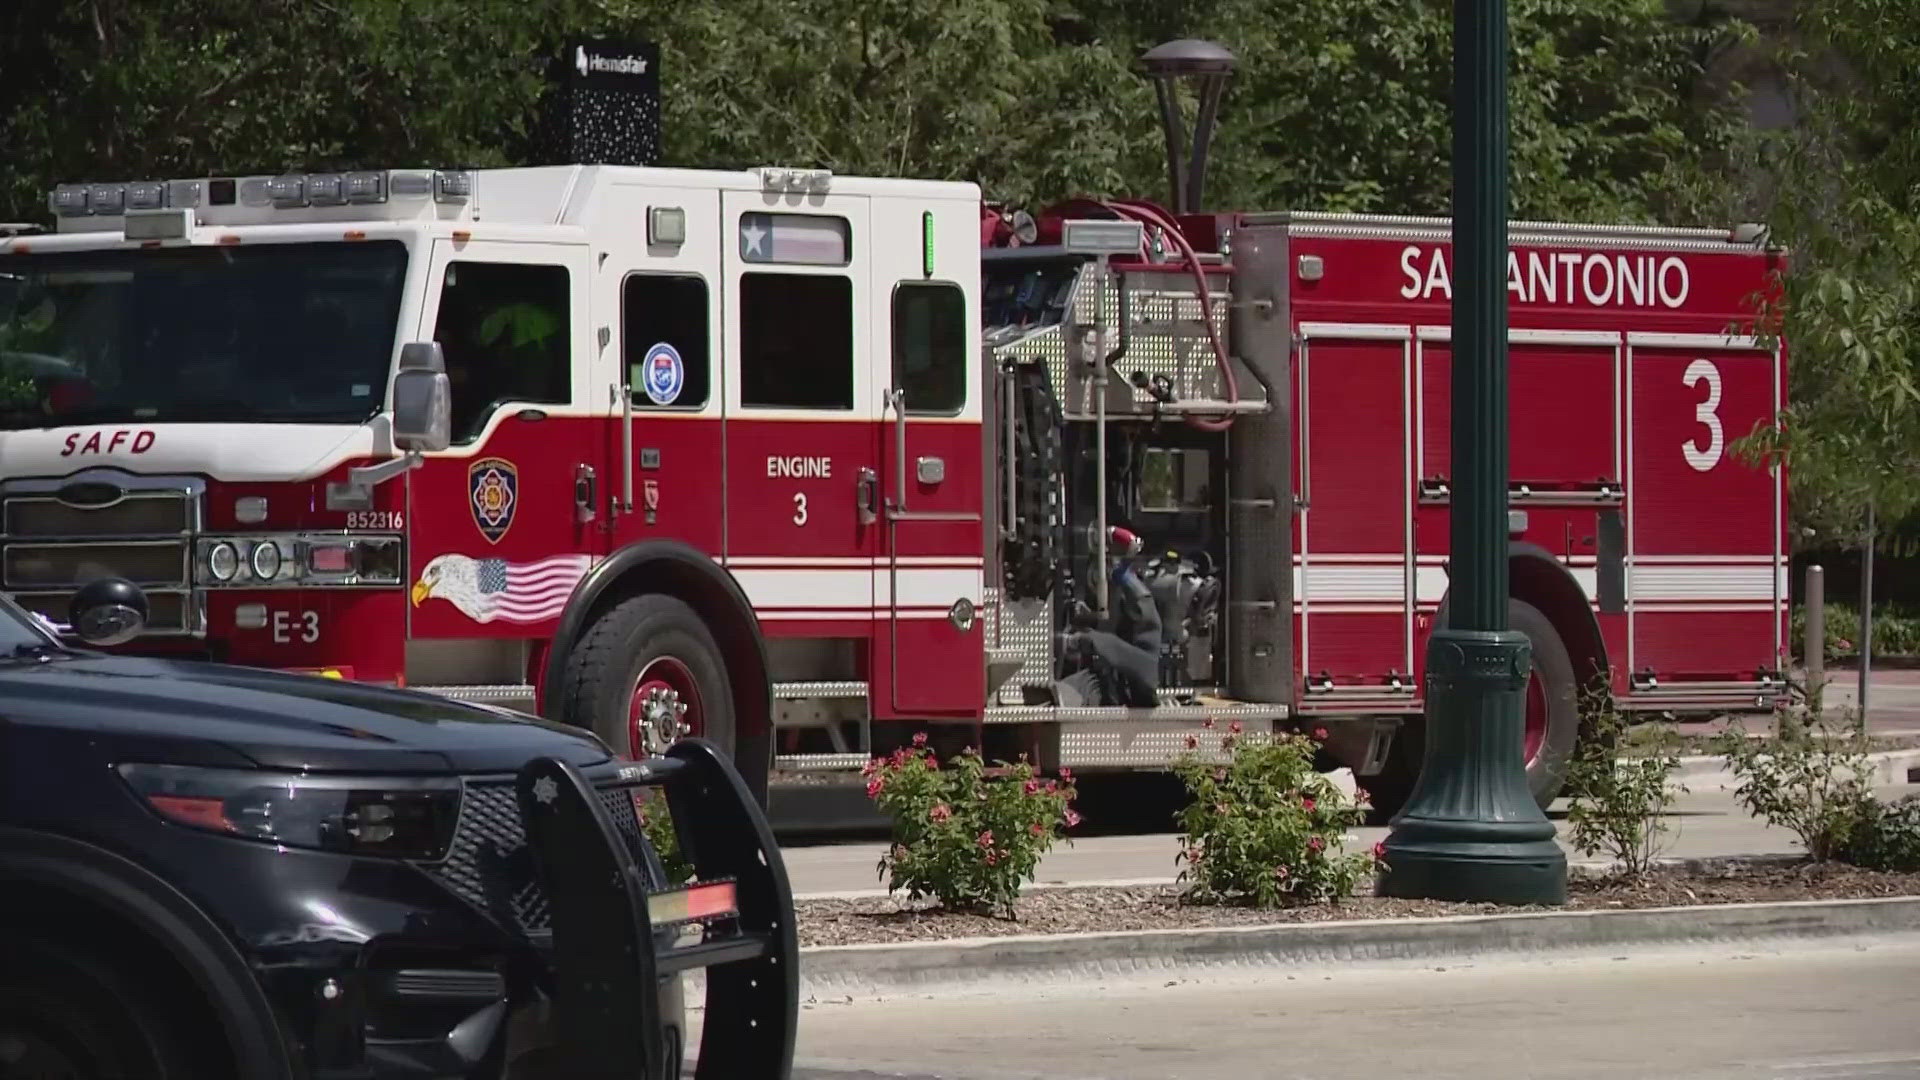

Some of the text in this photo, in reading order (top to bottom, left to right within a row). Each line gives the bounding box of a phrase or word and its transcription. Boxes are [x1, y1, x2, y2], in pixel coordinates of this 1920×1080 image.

[589, 53, 648, 74] Hemisfair
[1400, 245, 1690, 309] SA ANTONIO
[1681, 359, 1724, 472] 3
[60, 430, 156, 457] SAFD
[766, 456, 832, 479] ENGINE
[346, 511, 404, 529] 852316
[793, 492, 808, 526] 3
[273, 610, 320, 643] E-3
